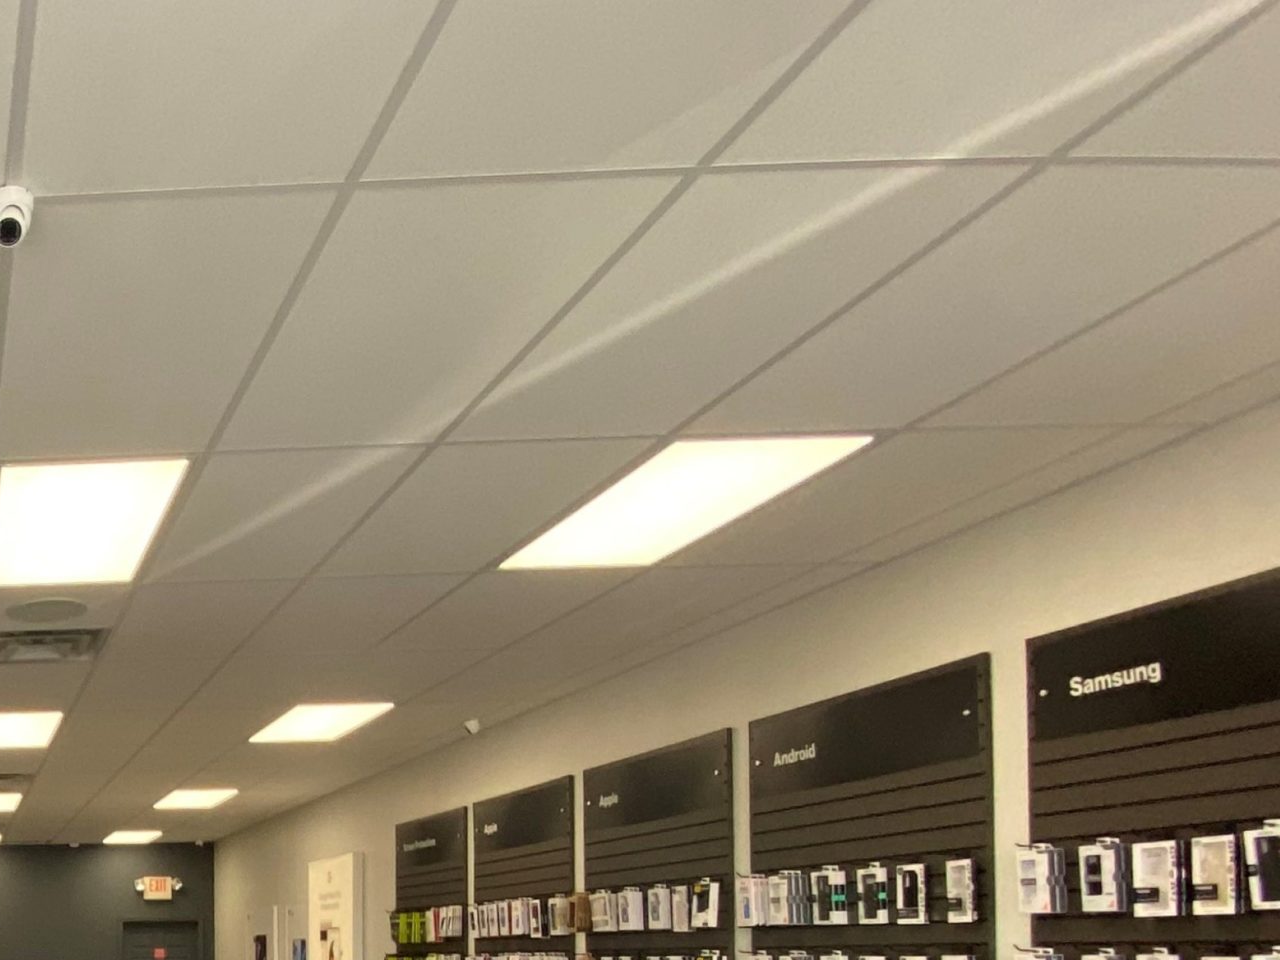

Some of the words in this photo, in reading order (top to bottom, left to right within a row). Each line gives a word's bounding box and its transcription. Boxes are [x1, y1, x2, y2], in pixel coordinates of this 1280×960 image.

[1068, 662, 1162, 697] Samsung
[773, 742, 816, 767] Android
[149, 879, 167, 893] EXIT
